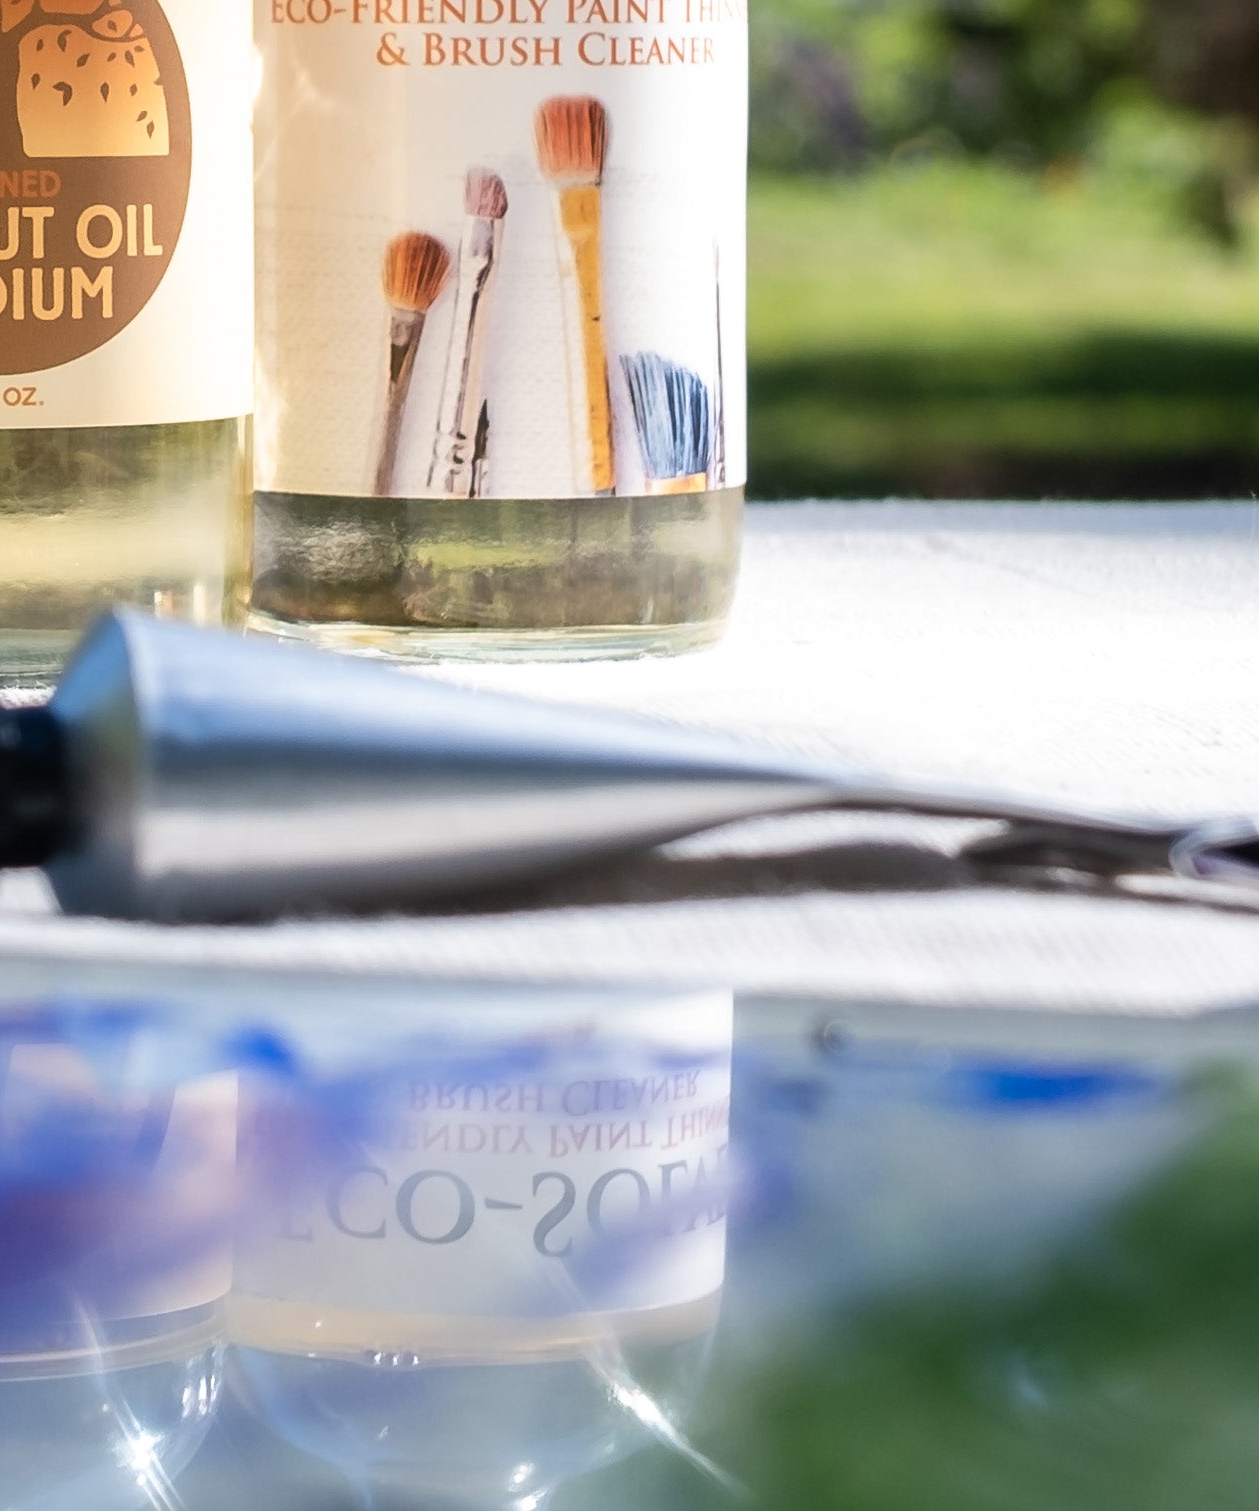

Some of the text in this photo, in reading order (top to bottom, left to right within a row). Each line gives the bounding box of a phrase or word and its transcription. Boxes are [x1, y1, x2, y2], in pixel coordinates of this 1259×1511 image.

[376, 31, 715, 67] & BRUSH CLEANER
[76, 203, 164, 259] OIL
[2, 387, 45, 407] OZ.
